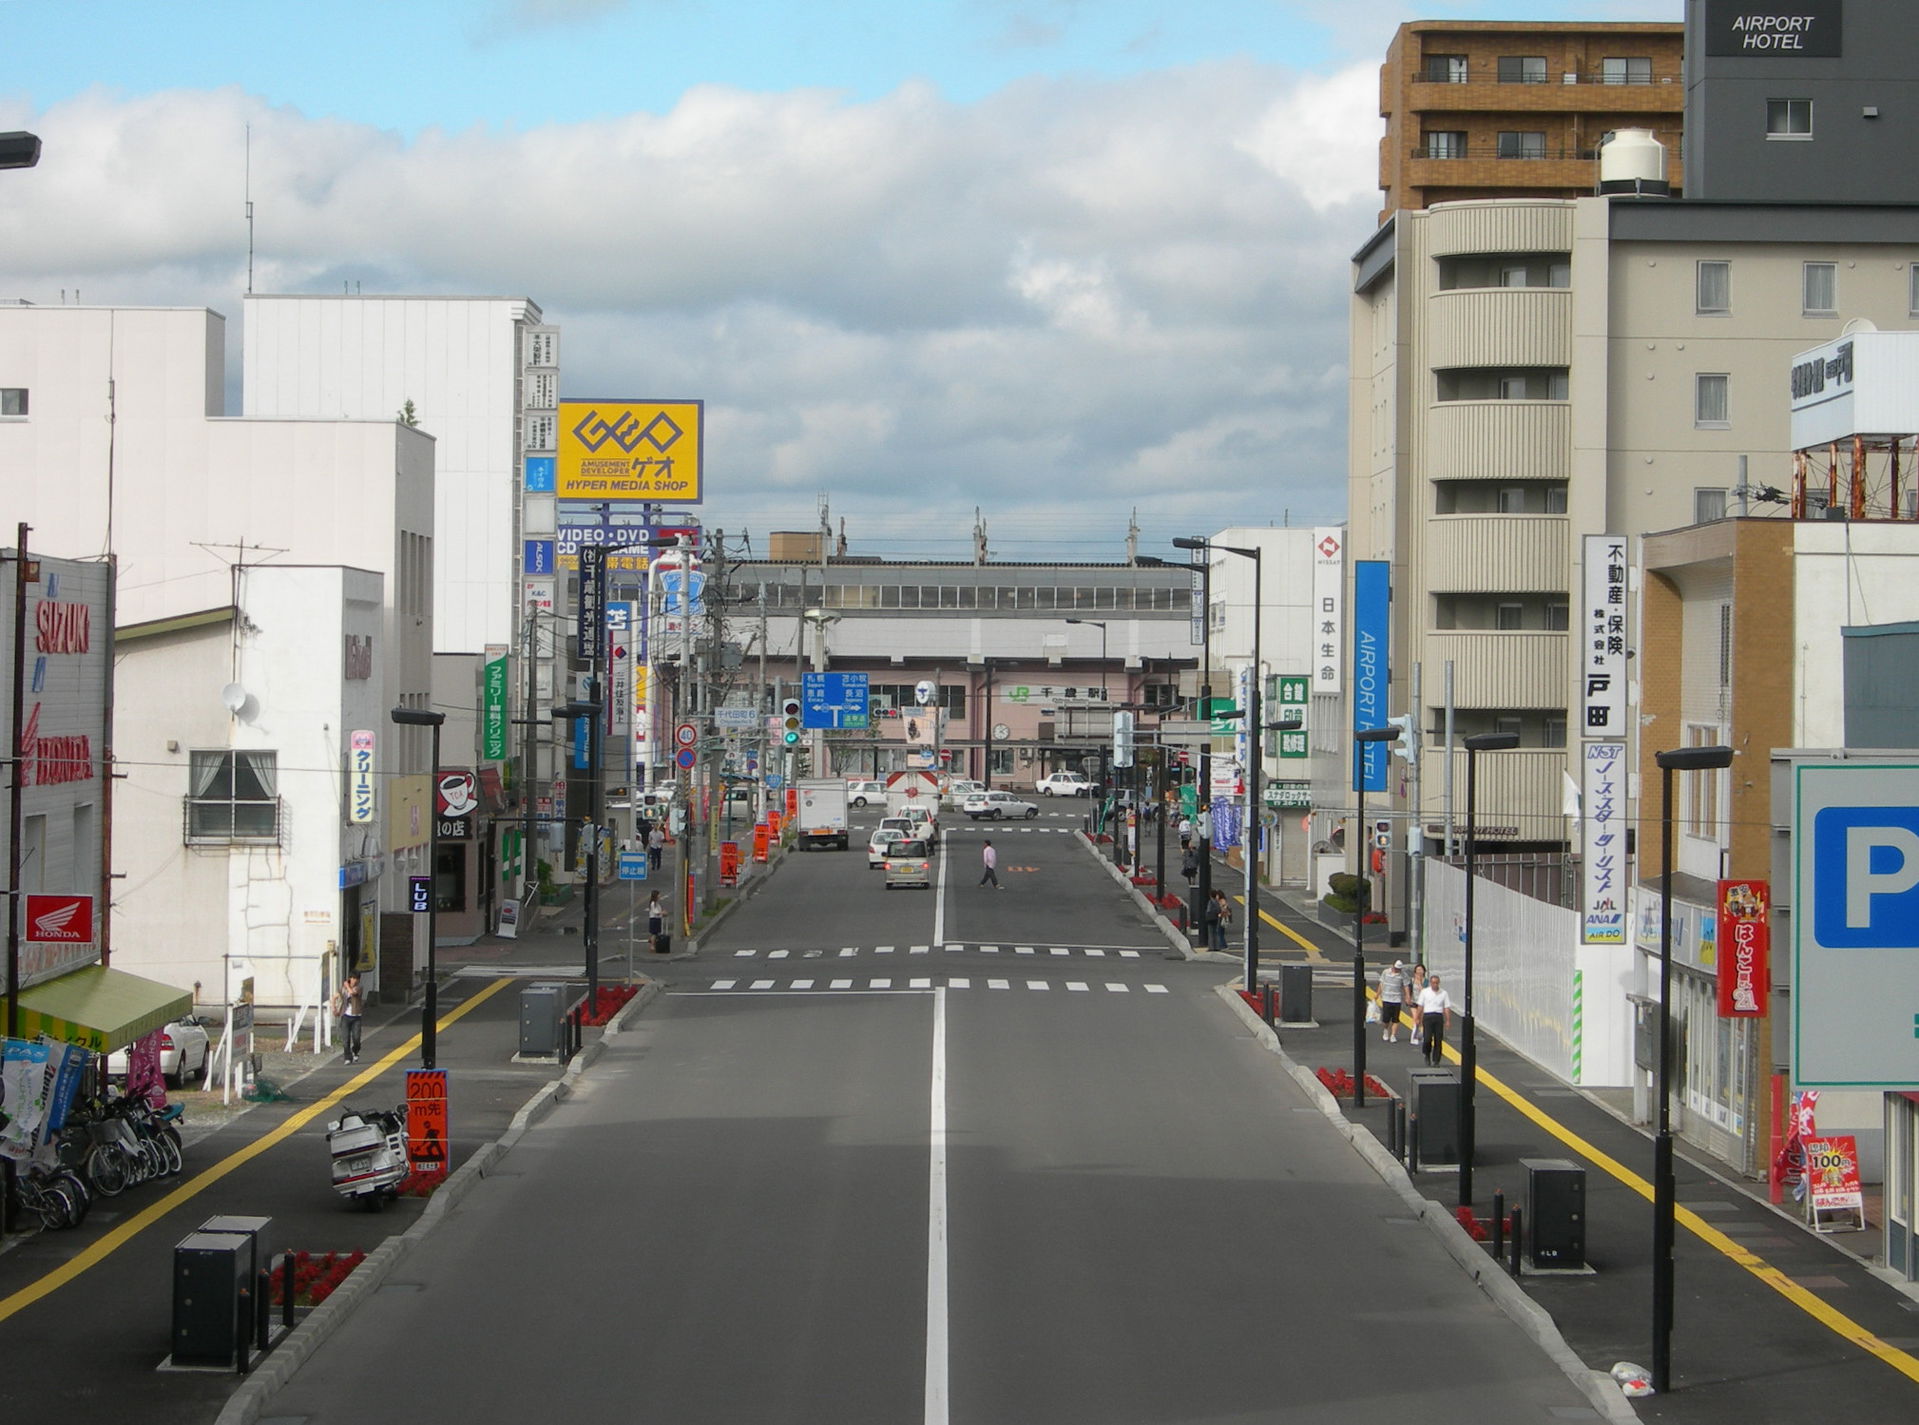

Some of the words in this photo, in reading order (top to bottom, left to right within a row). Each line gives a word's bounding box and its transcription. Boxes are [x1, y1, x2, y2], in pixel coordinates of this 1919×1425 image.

[1732, 16, 1814, 32] AIRPORT
[1743, 34, 1803, 49] HOTEL
[632, 456, 675, 479] ゲオ
[566, 480, 607, 490] HYPER
[610, 480, 650, 491] MEDIA
[654, 480, 689, 491] SHOP
[557, 529, 604, 541] VIDEO
[617, 529, 649, 541] DVD
[557, 541, 576, 554] CD
[535, 542, 544, 573] ALSOK
[1608, 545, 1623, 656] 不動産・保険
[36, 600, 90, 654] SUZUKI
[1321, 597, 1336, 680] 日本生命
[1594, 609, 1605, 665] 株式会社
[1360, 631, 1375, 717] AIRPORT
[1009, 687, 1029, 698] JR
[1041, 688, 1100, 698] 千歳駅
[1587, 674, 1610, 727] 戸田
[681, 730, 692, 740] 40
[1587, 745, 1623, 759] NST
[37, 735, 93, 786] HONDA
[355, 750, 371, 820] クリーニング
[1846, 827, 1919, 928] P
[1593, 898, 1616, 912] JAL
[1587, 914, 1610, 924] ANA
[35, 930, 80, 938] HONDA
[1589, 931, 1604, 939] AIR
[1605, 929, 1620, 938] DO
[410, 1082, 443, 1102] 200
